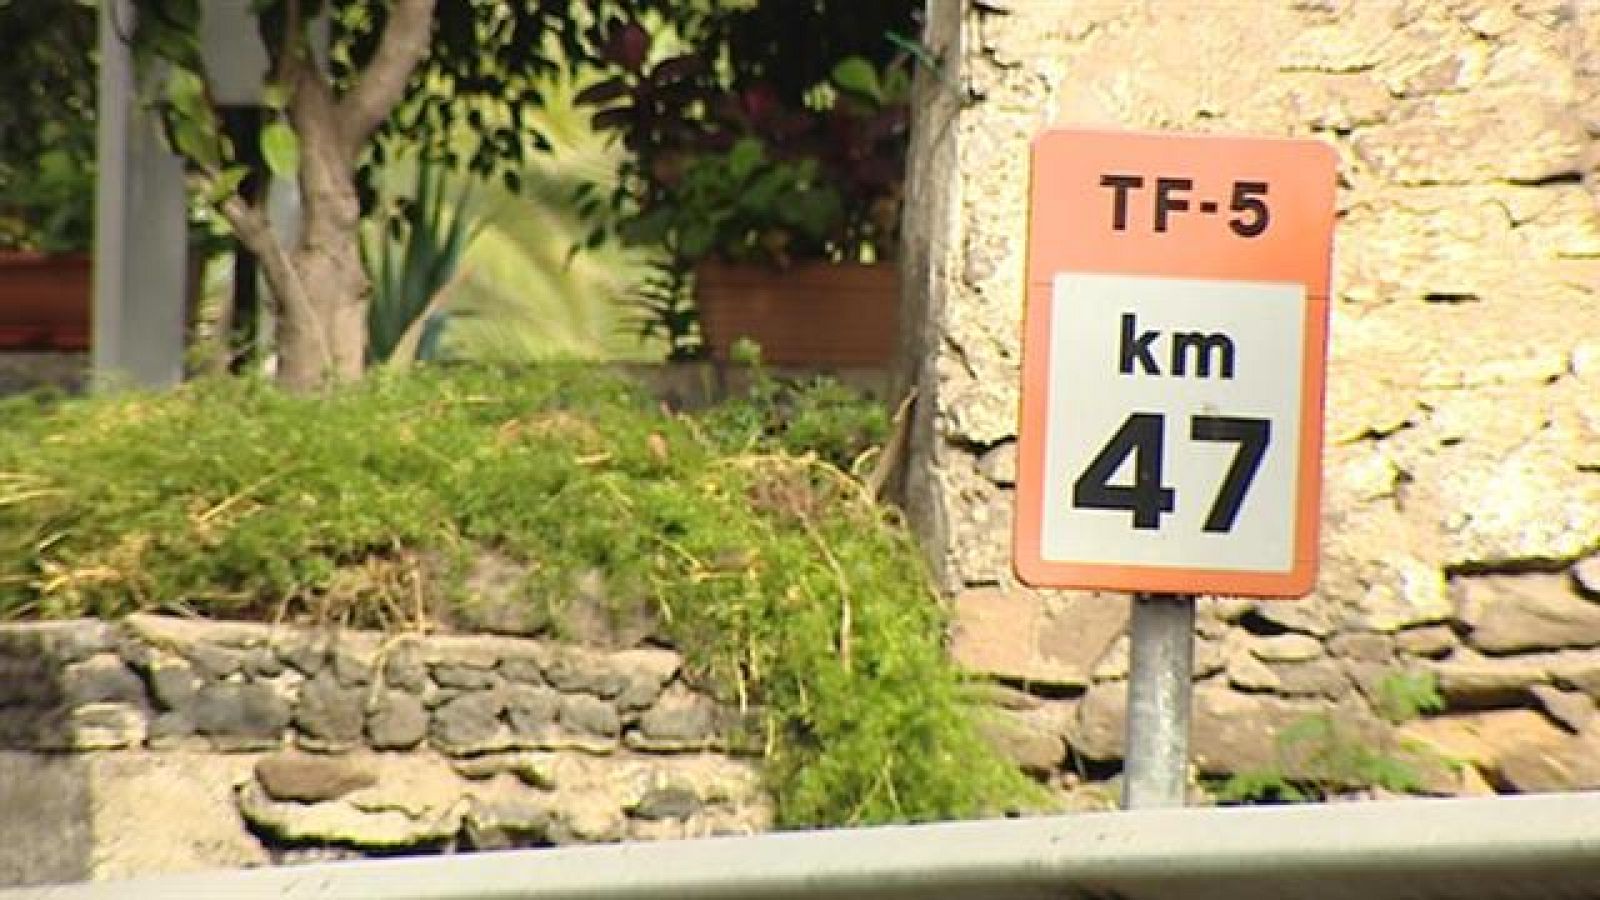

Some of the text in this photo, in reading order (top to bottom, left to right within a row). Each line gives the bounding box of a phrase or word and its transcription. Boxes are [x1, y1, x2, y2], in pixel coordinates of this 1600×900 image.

[1100, 174, 1270, 238] TF-5
[1119, 313, 1235, 379] km
[1072, 412, 1271, 533] 47
